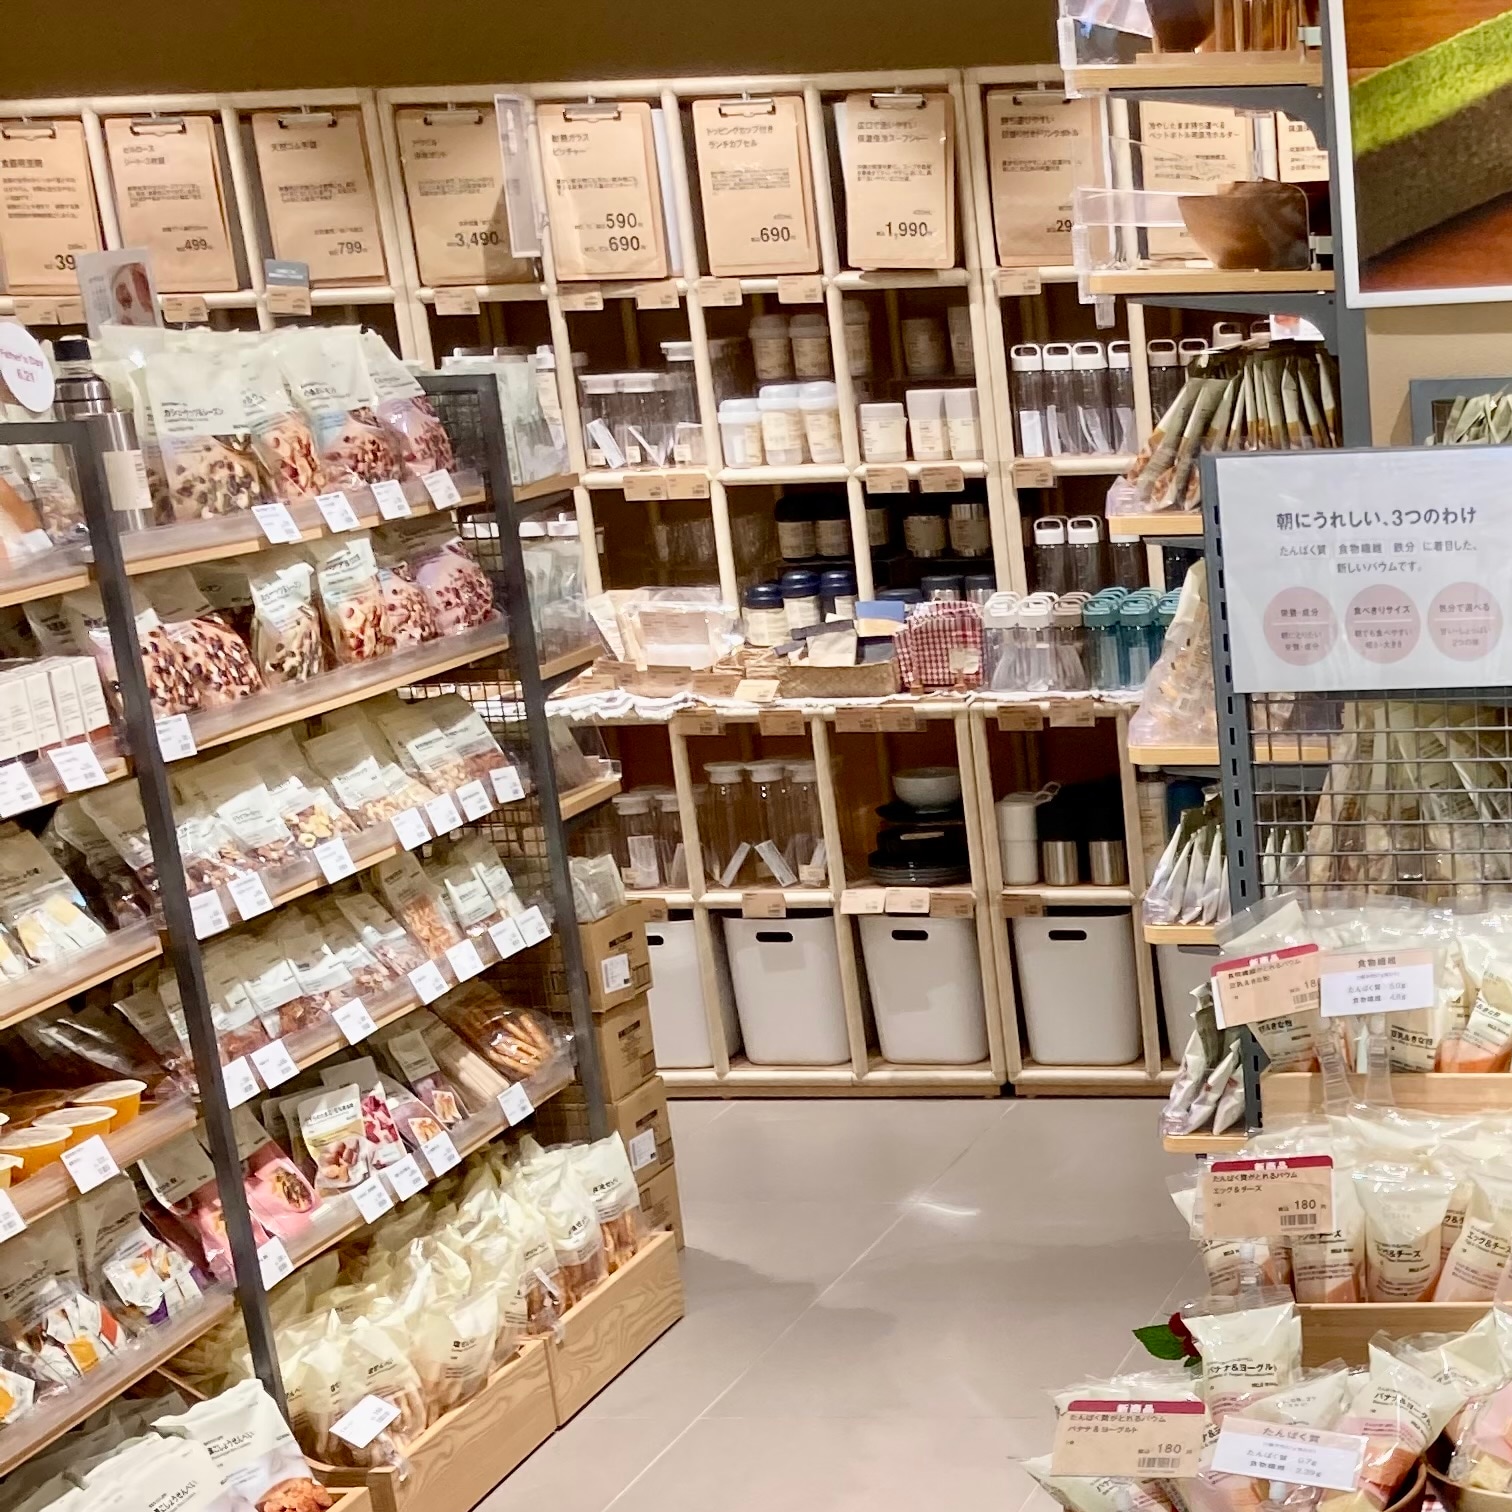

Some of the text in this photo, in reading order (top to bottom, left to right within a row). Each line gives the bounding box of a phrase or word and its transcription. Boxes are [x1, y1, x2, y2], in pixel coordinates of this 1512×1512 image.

[605, 213, 638, 229] 590
[760, 226, 791, 242] 690
[884, 221, 929, 240] 1,990
[184, 238, 208, 251] 499
[454, 231, 500, 249] 3,490
[608, 236, 641, 252] 690
[337, 241, 362, 255] 799
[1276, 507, 1477, 531] 朝にうれしい、3つのわけ
[1393, 541, 1415, 553] 鉄分
[1337, 561, 1422, 574] 新しいバウムです。
[1354, 605, 1411, 616] 食べきりサイズ
[1439, 602, 1490, 614] 気分で選べる
[1294, 1199, 1317, 1210] 180
[1157, 1443, 1183, 1454] 180
